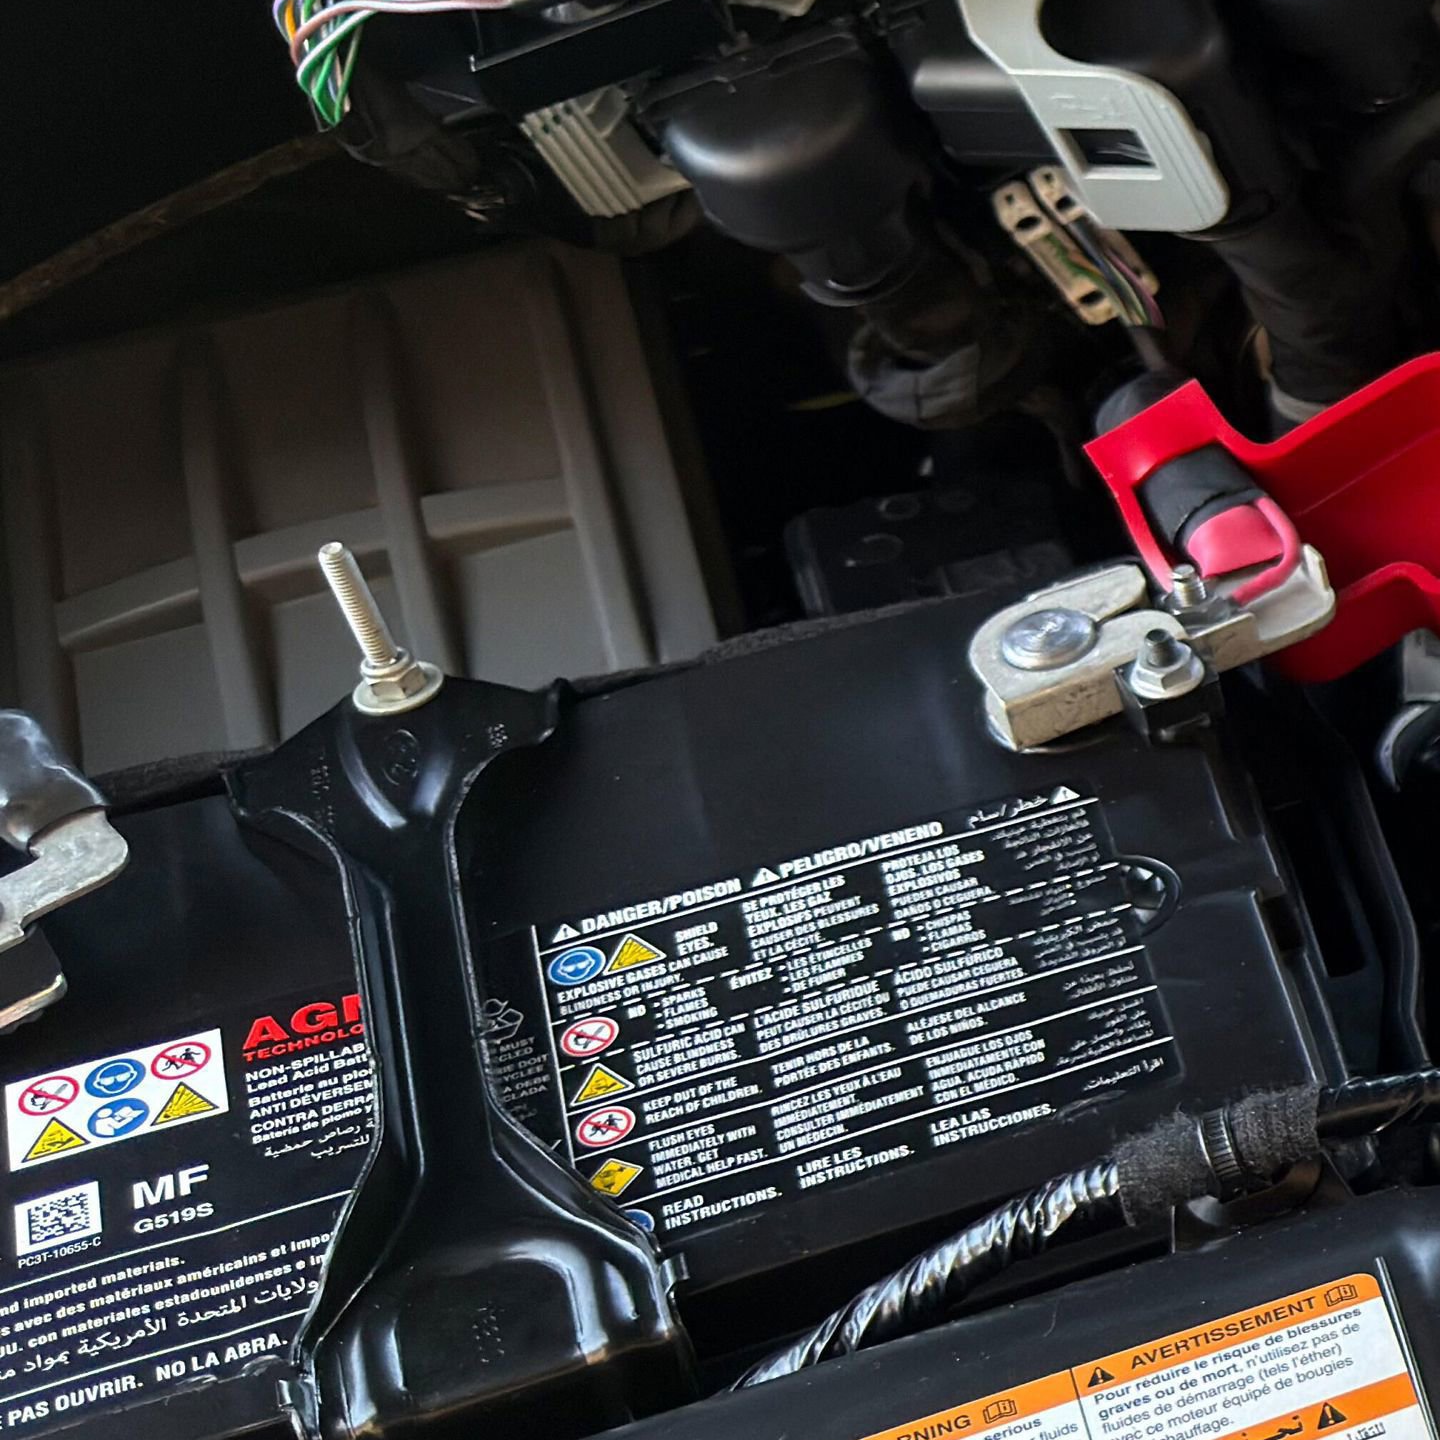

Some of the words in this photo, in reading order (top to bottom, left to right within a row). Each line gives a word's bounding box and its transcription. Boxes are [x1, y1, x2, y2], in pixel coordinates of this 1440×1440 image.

[778, 820, 944, 879] PELIGRO/VENENO
[579, 876, 743, 935] DANGER/POISON
[244, 1041, 366, 1083] NON-SPILLAB
[245, 1072, 289, 1094] Lead
[291, 1061, 330, 1081] Acid
[331, 1049, 368, 1070] Batt
[928, 1116, 961, 1135] LEA
[959, 1106, 992, 1126] LAS
[932, 1102, 1057, 1147] INSTRUCCIONES.
[795, 1154, 833, 1177] LIRE
[832, 1145, 863, 1165] LES
[798, 1143, 916, 1190] INSTRUCTIONS.
[131, 1163, 210, 1210] MF
[661, 1193, 705, 1217] READ
[663, 1185, 783, 1231] INSTRUCTIONS.
[132, 1201, 215, 1234] G519S
[12, 1311, 53, 1333] avec
[54, 1301, 86, 1319] des
[88, 1277, 174, 1309] matériaux
[175, 1250, 268, 1285] américains
[269, 1243, 287, 1258] et
[289, 1229, 335, 1253] impo
[22, 1276, 98, 1309] imported
[100, 1255, 186, 1286] materials.
[26, 1330, 58, 1349] con
[60, 1303, 151, 1338] materiales
[153, 1263, 293, 1311] estadounidenses
[154, 1359, 186, 1382] NO
[190, 1350, 221, 1372] LA
[223, 1331, 289, 1364] ABRA.
[1092, 1384, 1132, 1405] Pour
[1134, 1365, 1191, 1392] réduire
[1192, 1359, 1209, 1371] le
[1210, 1341, 1261, 1365] risque
[1263, 1333, 1284, 1347] de
[1285, 1307, 1362, 1340] blessures
[1129, 1294, 1317, 1370] AVERTISSEMENT
[1097, 1393, 1153, 1422] graves
[1153, 1385, 1176, 1400] ou
[1177, 1377, 1199, 1392] de
[1200, 1362, 1244, 1384] mort,
[1244, 1339, 1309, 1369] n'utilisez
[1310, 1329, 1340, 1349] pas
[1340, 1322, 1361, 1336] de
[6, 1399, 50, 1427] PAS
[53, 1373, 144, 1412] OUVRIR.
